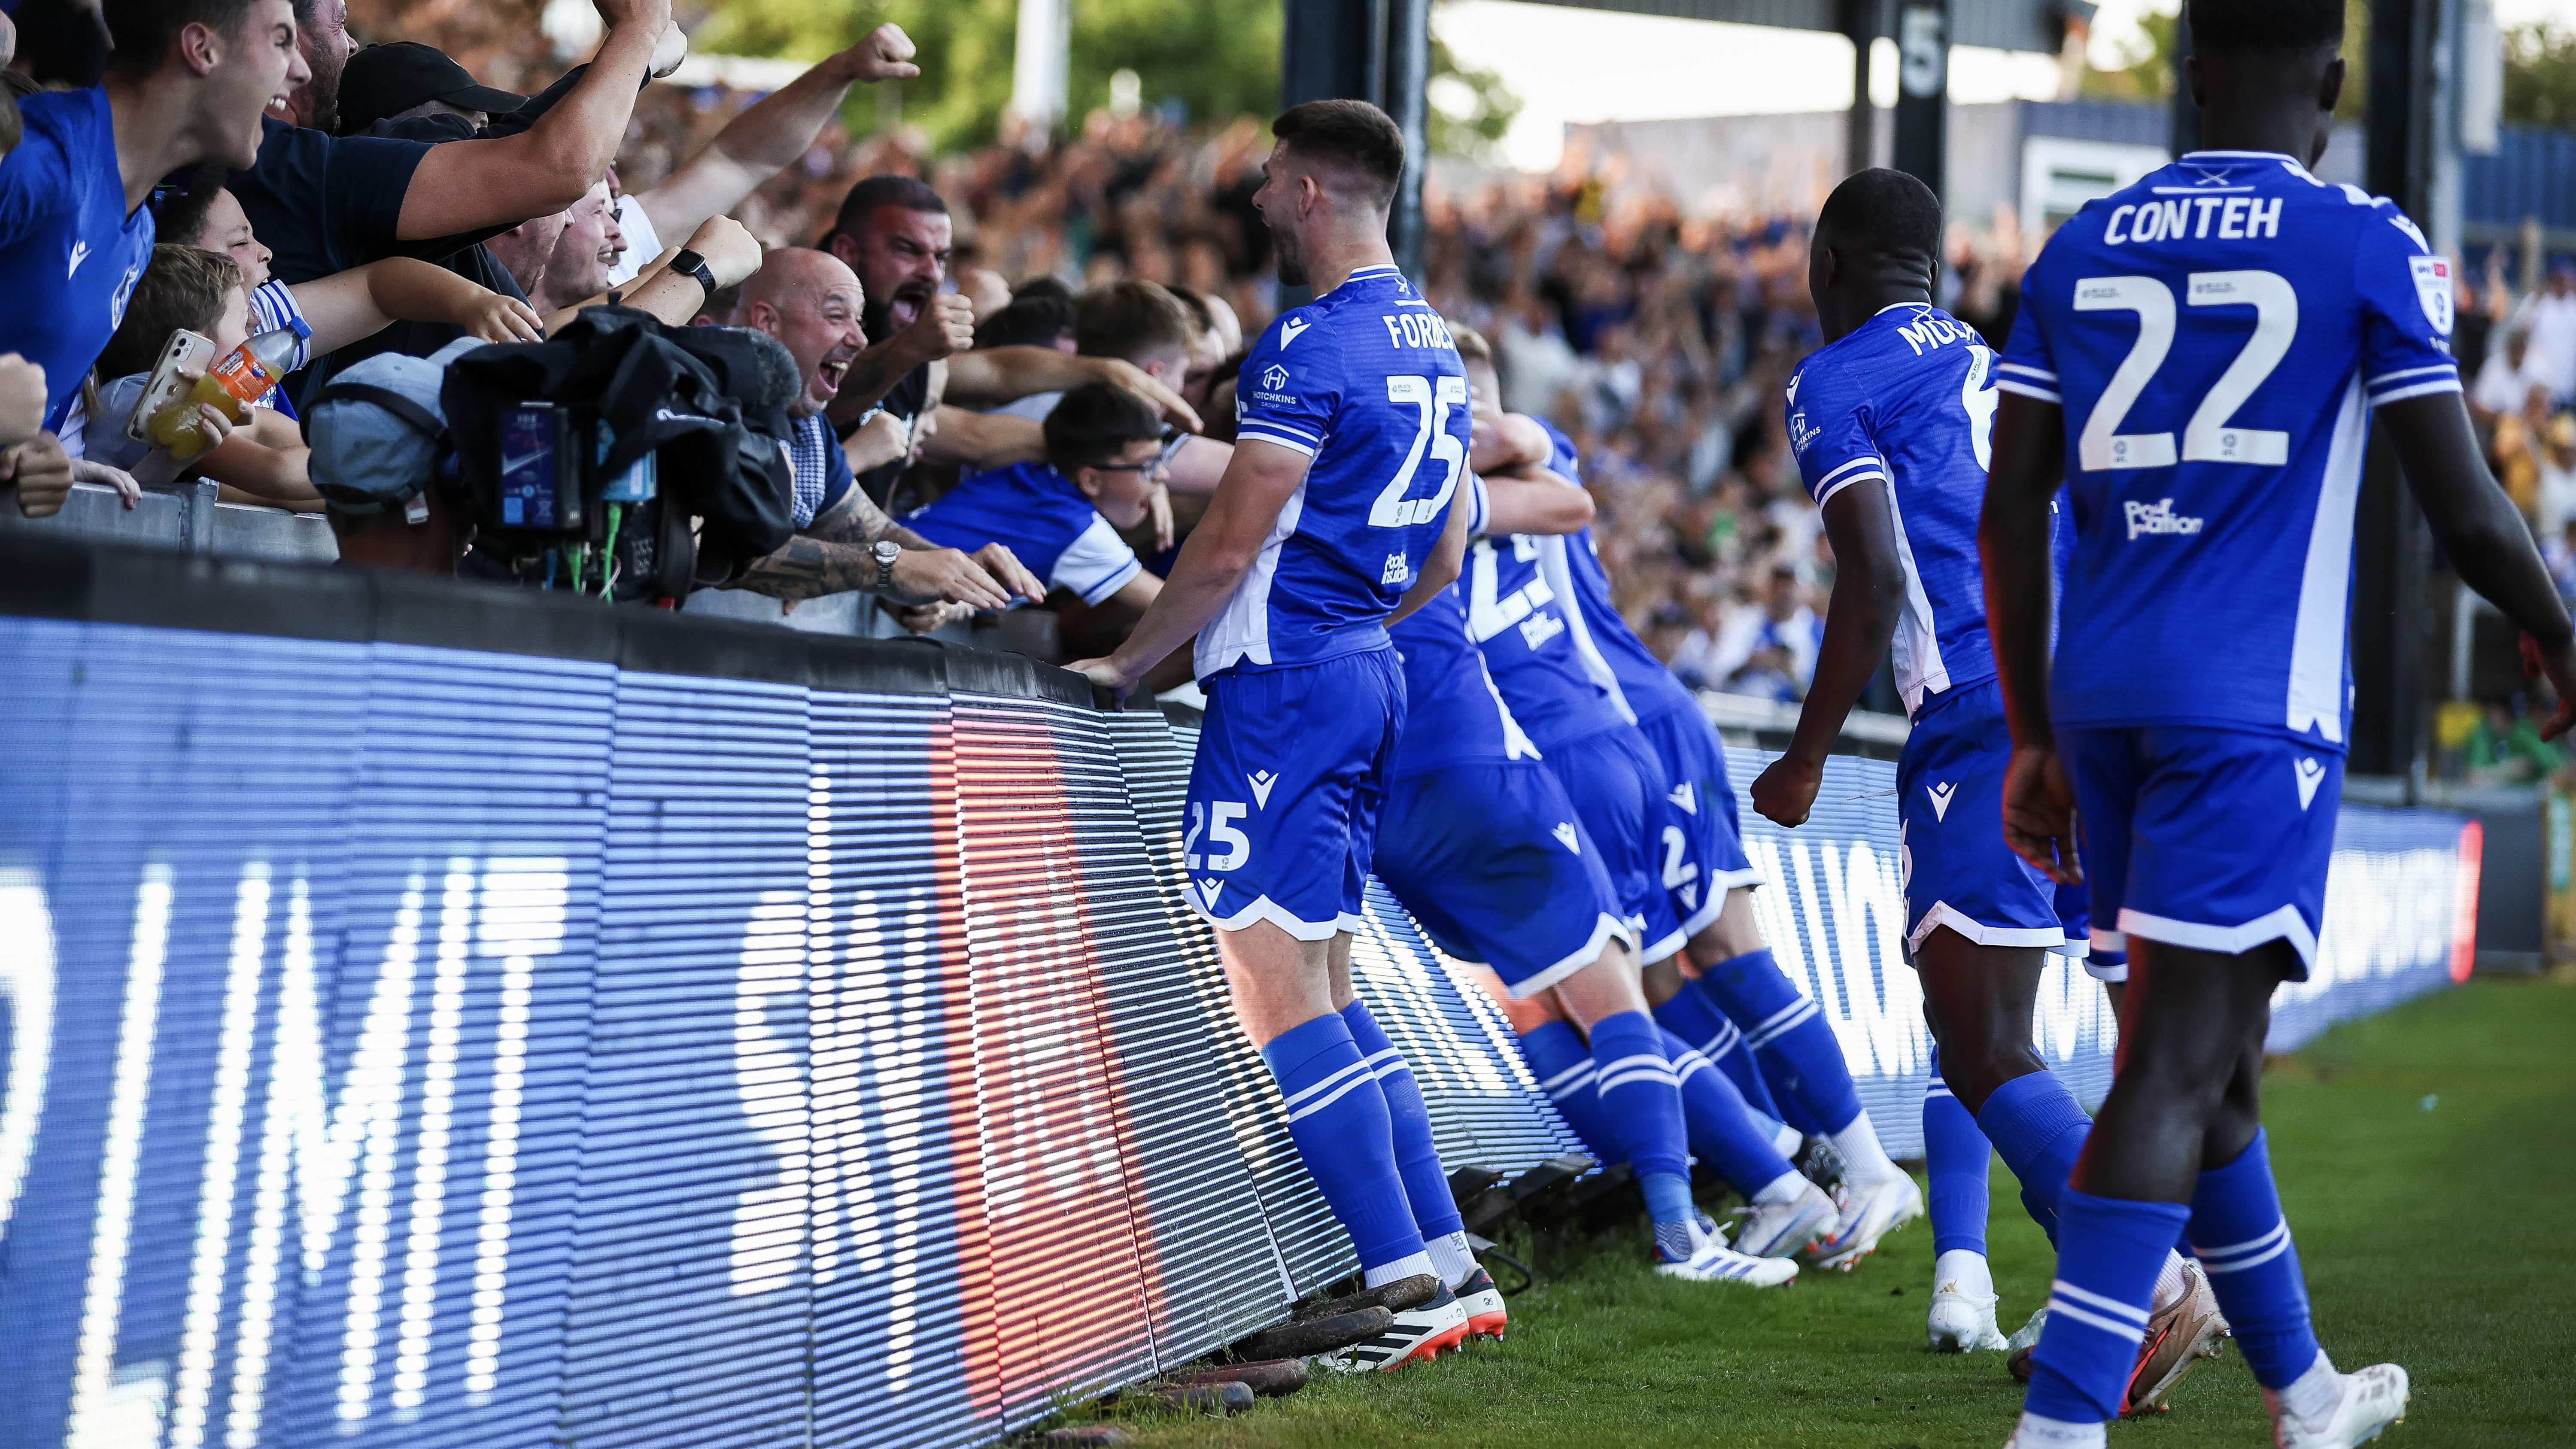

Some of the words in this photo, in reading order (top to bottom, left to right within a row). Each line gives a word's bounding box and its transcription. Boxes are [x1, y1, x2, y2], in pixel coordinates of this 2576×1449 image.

[1900, 5, 1945, 97] 5
[2104, 197, 2283, 245] CONTEH
[1382, 313, 1455, 350] FORBES
[2072, 269, 2299, 472] 22
[1253, 391, 1296, 404] HOTCHKINS
[1368, 375, 1467, 528] 25
[1183, 801, 1250, 872] 25
[65, 857, 568, 1449] LIMIT
